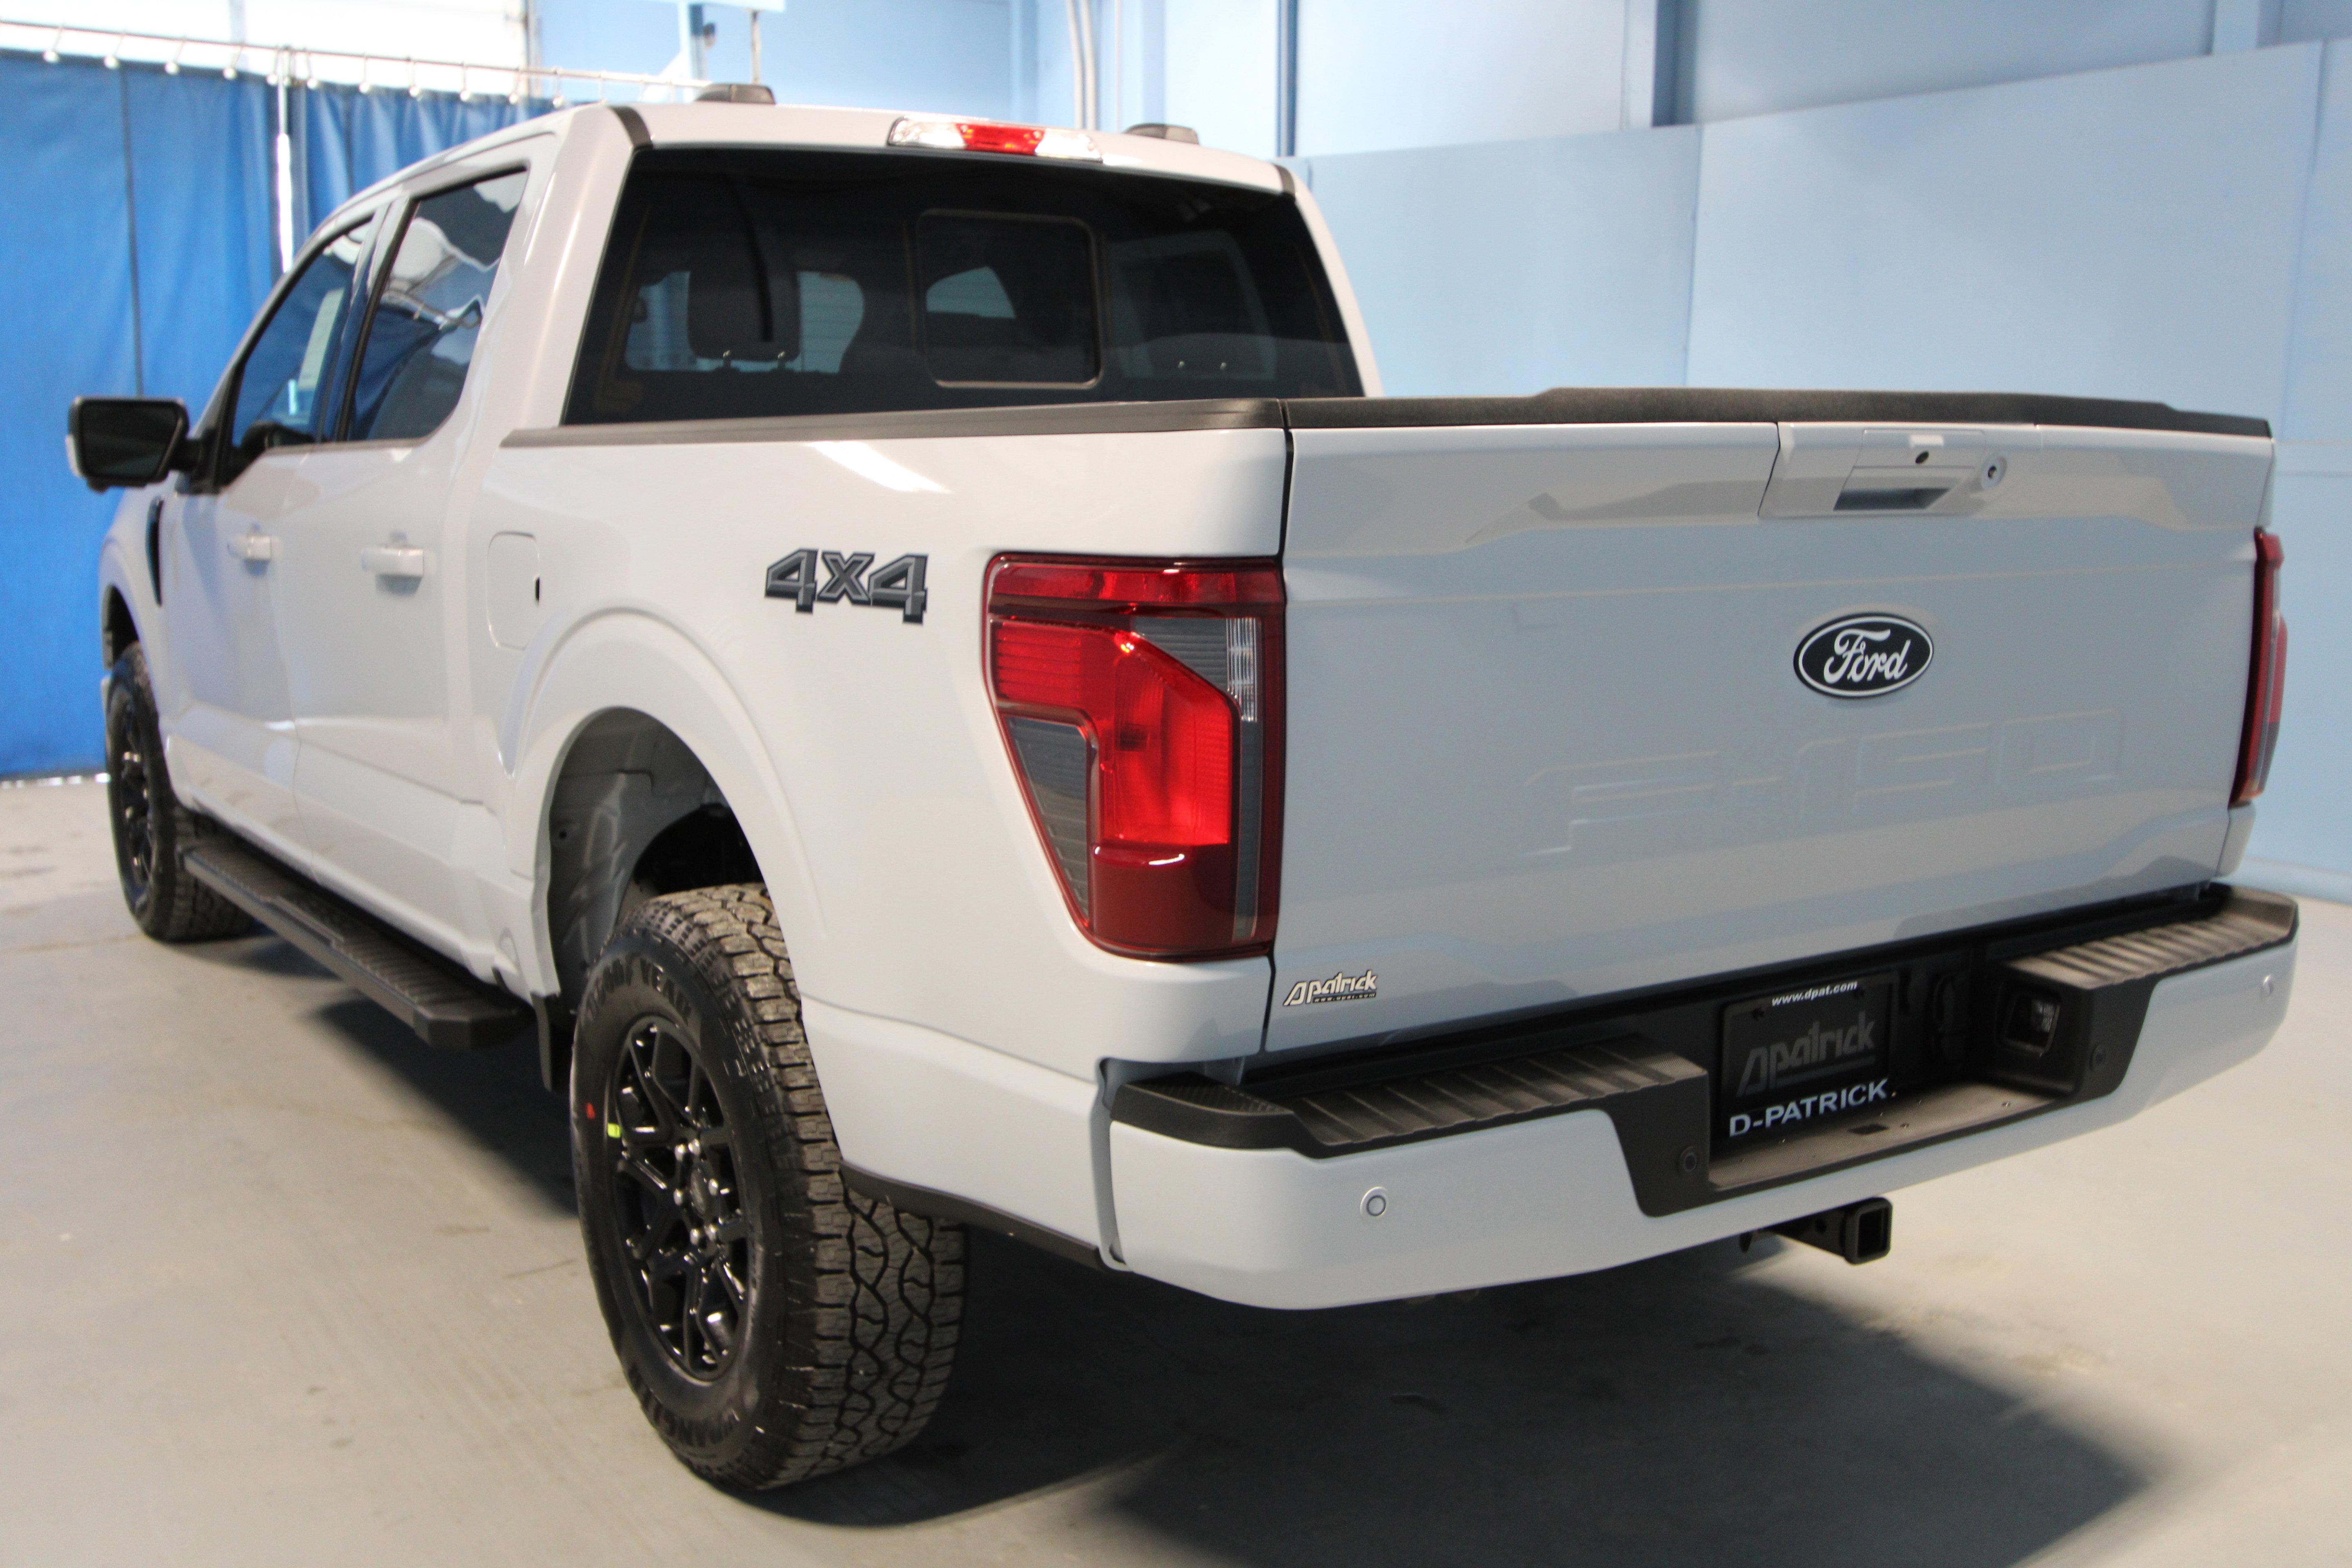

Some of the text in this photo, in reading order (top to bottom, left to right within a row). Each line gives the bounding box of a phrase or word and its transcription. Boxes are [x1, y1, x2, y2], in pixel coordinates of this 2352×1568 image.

[1823, 628, 1911, 684] Ford
[1771, 981, 1858, 1007] www.dpat.com
[1729, 1077, 1889, 1138] D-PATRICK
